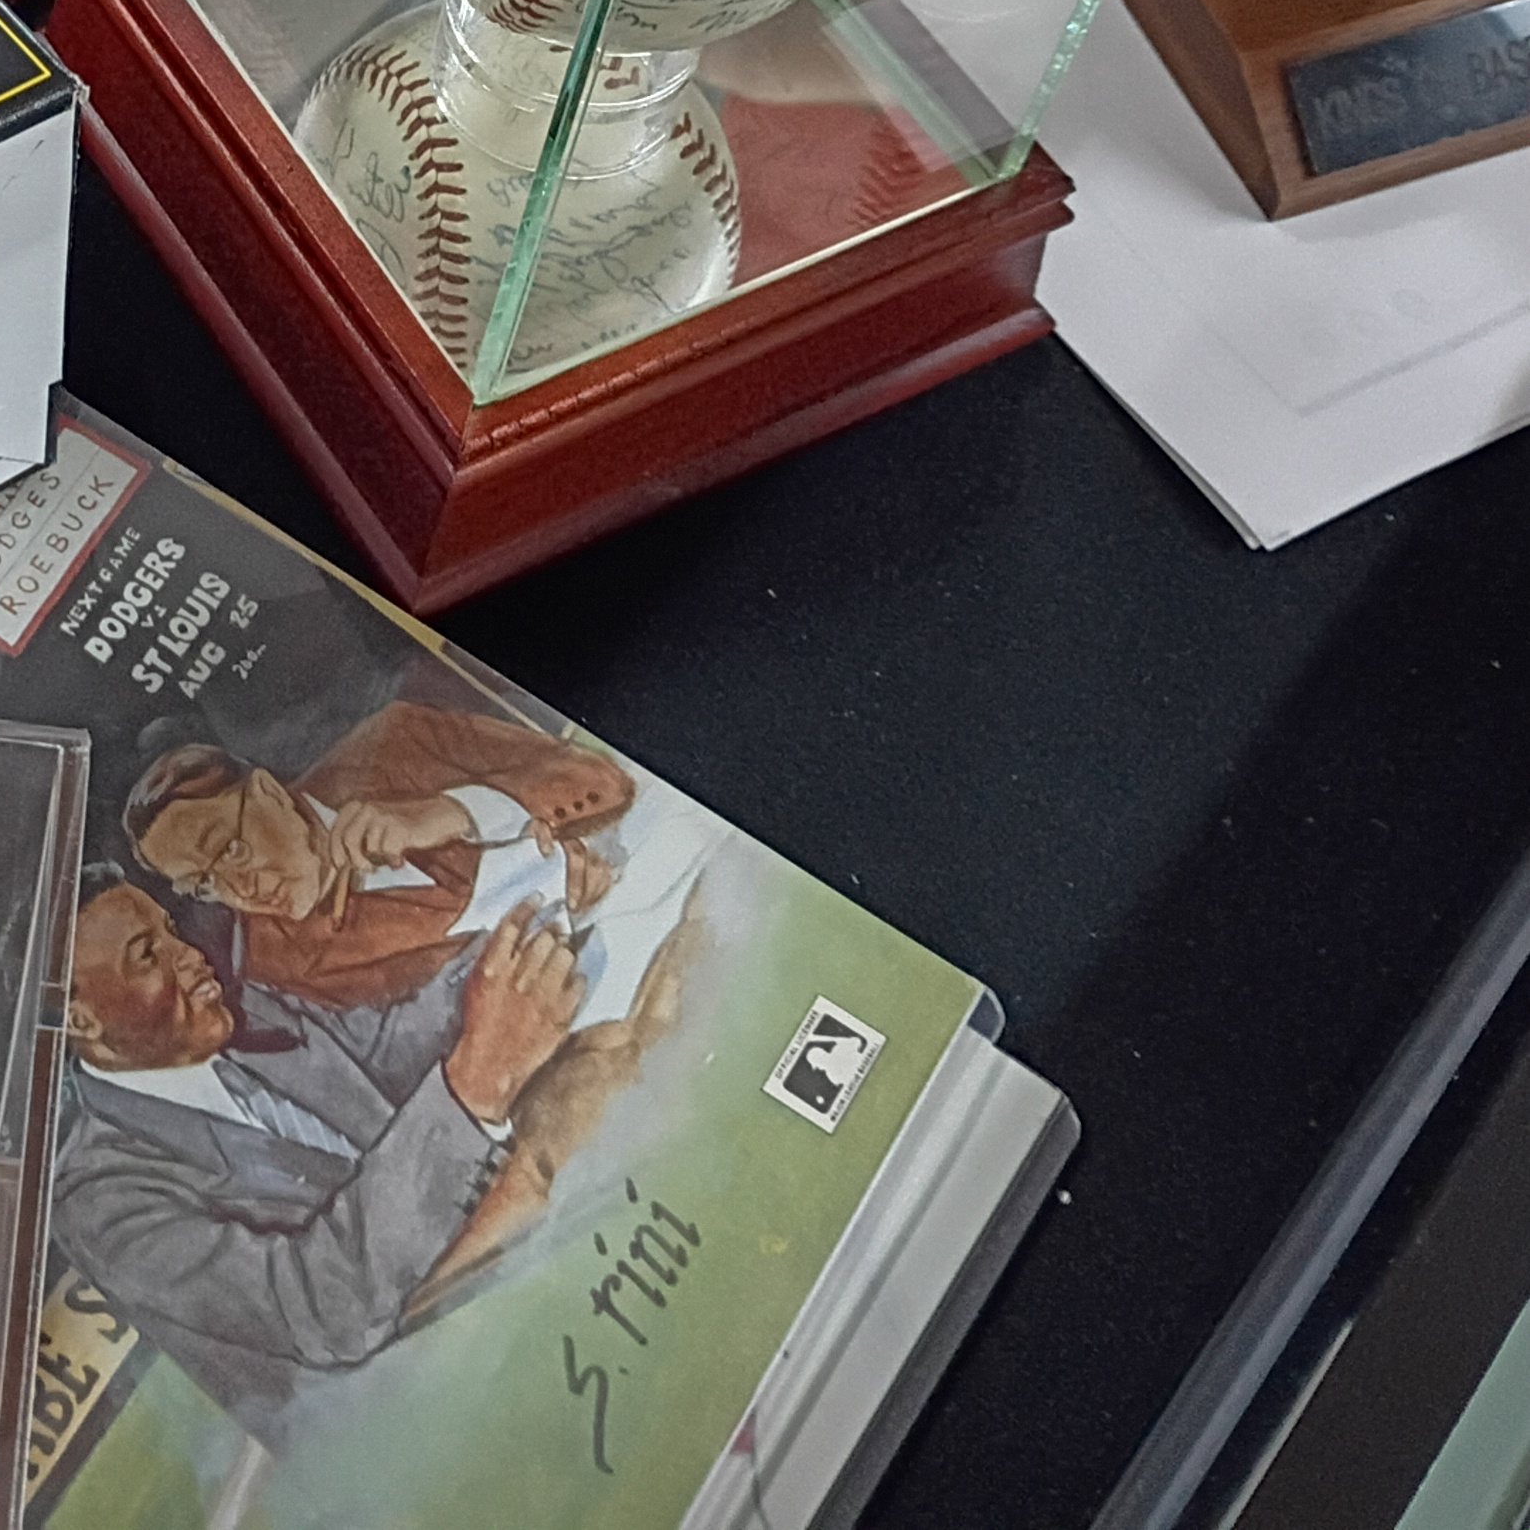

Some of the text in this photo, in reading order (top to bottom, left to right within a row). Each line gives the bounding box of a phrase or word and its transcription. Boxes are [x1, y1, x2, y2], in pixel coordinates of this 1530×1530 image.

[59, 525, 142, 638] NEXT GAME
[83, 537, 186, 665] DODGERS
[131, 570, 232, 695] ST LOUIS
[177, 593, 260, 699] AUG 25
